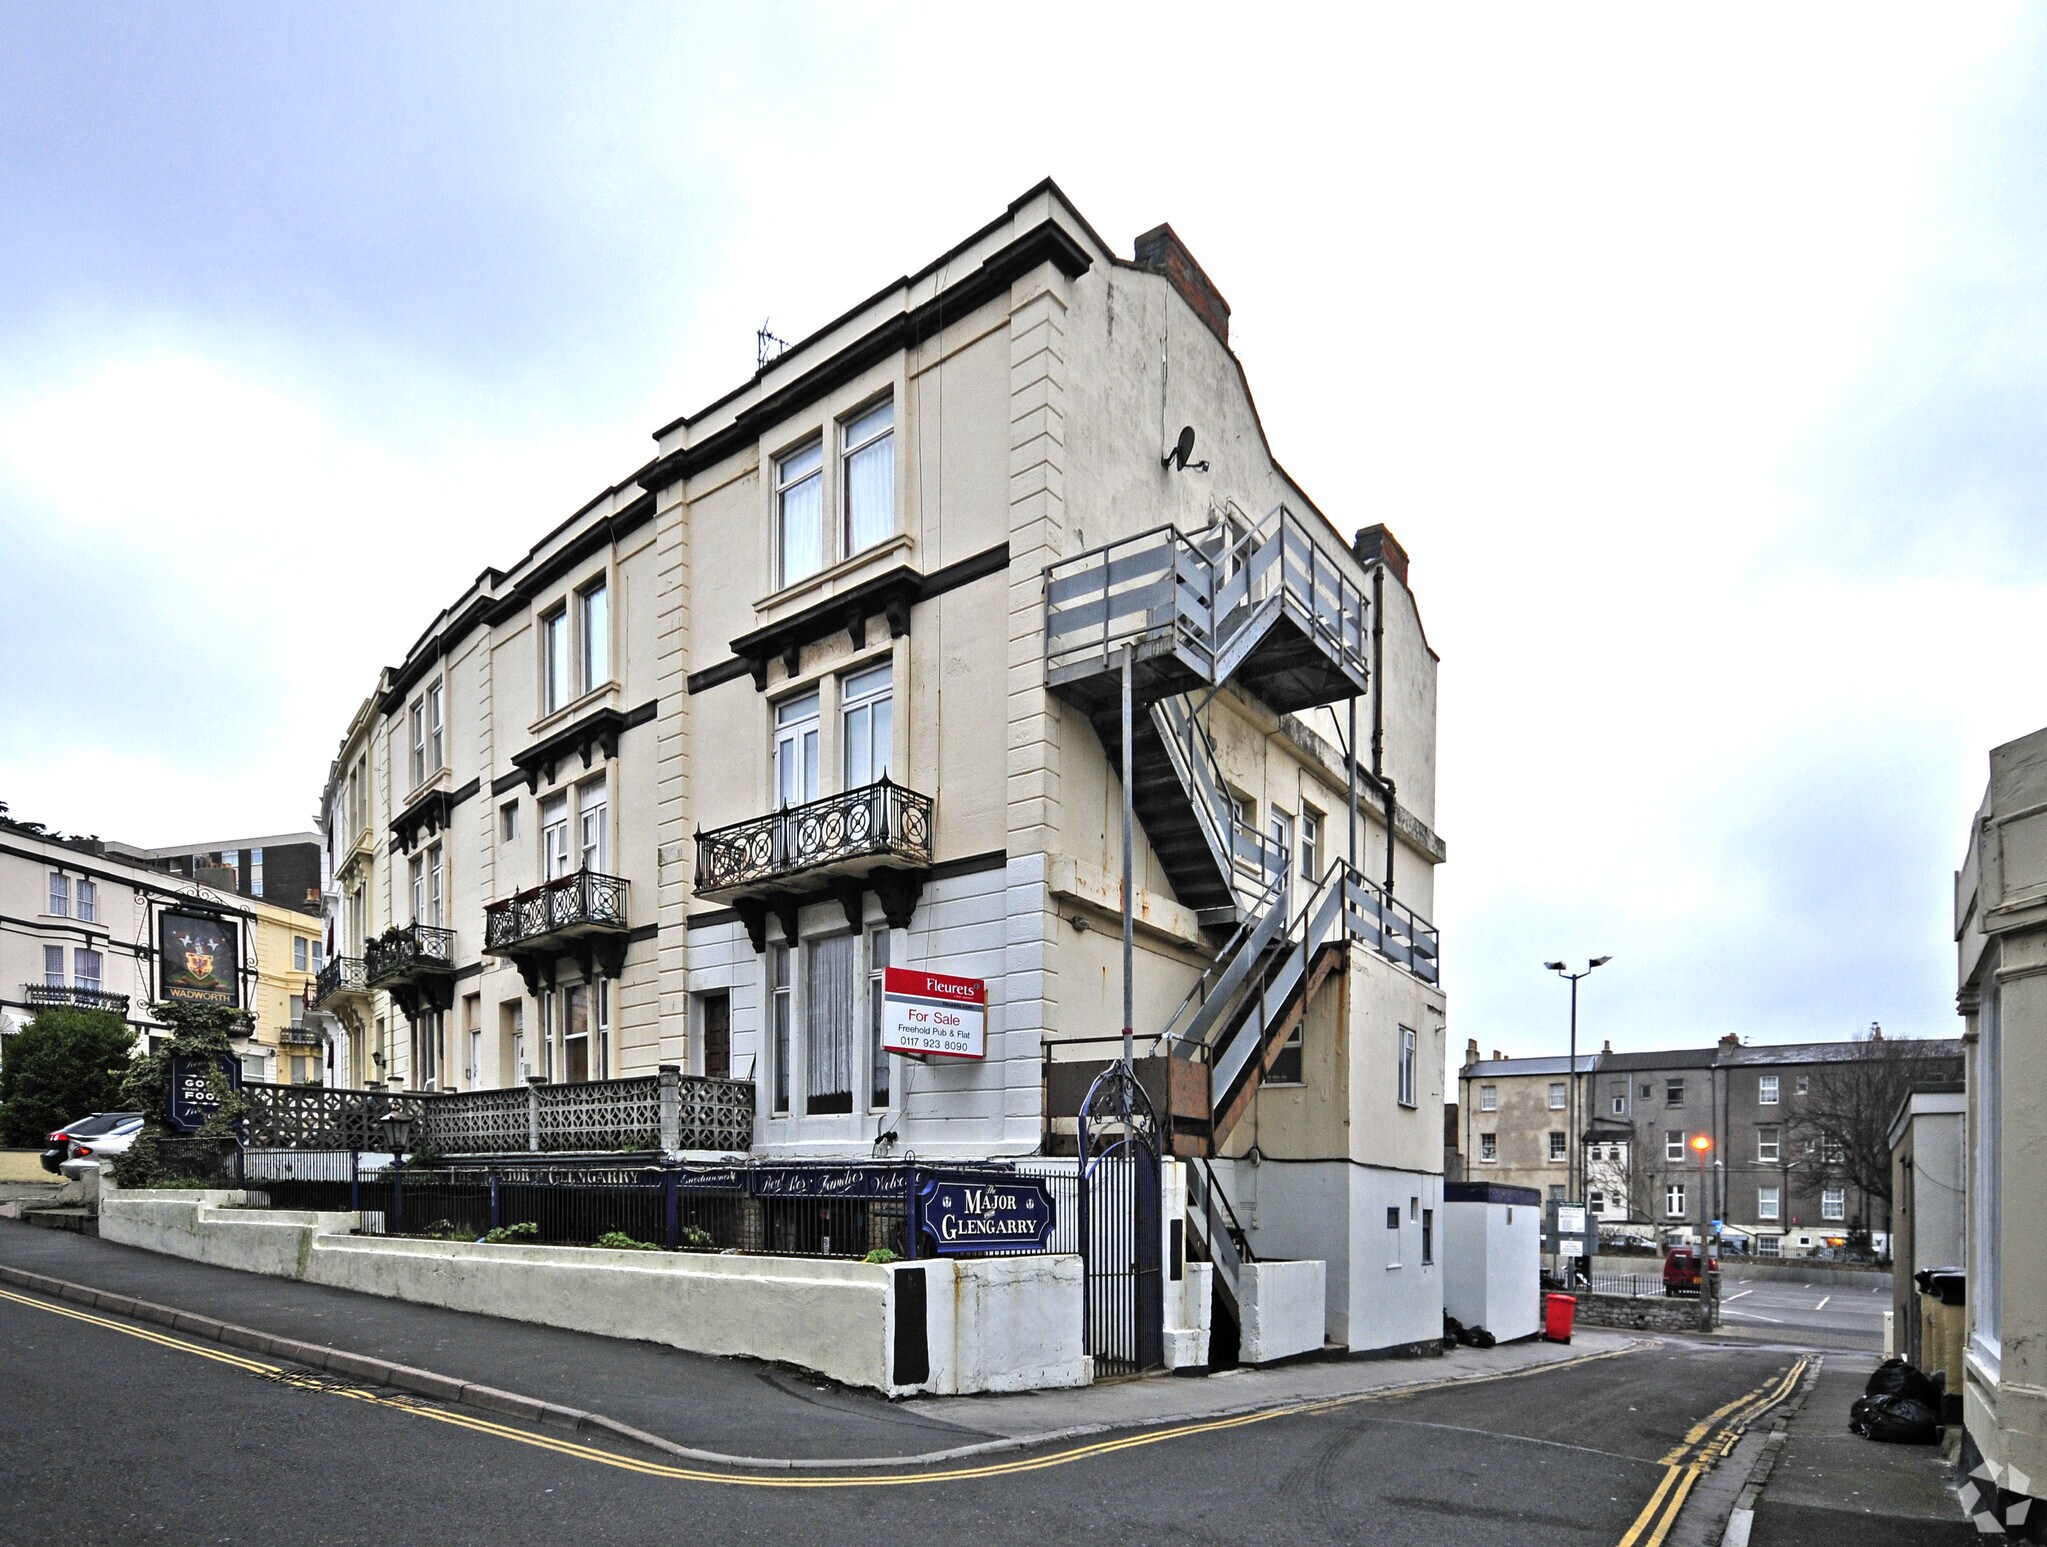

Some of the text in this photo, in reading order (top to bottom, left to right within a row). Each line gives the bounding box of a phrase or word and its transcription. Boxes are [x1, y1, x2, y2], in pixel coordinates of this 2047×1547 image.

[169, 988, 231, 1003] WADWORTH
[926, 977, 975, 996] Fleurets
[908, 1008, 960, 1026] For Sale
[898, 1023, 931, 1036] Freehold
[932, 1027, 947, 1037] Pub
[957, 1030, 970, 1039] Flat
[900, 1036, 968, 1051] 0117 923 8090
[963, 1188, 1017, 1215] MAJOR
[941, 1213, 1037, 1240] GLENGARRY
